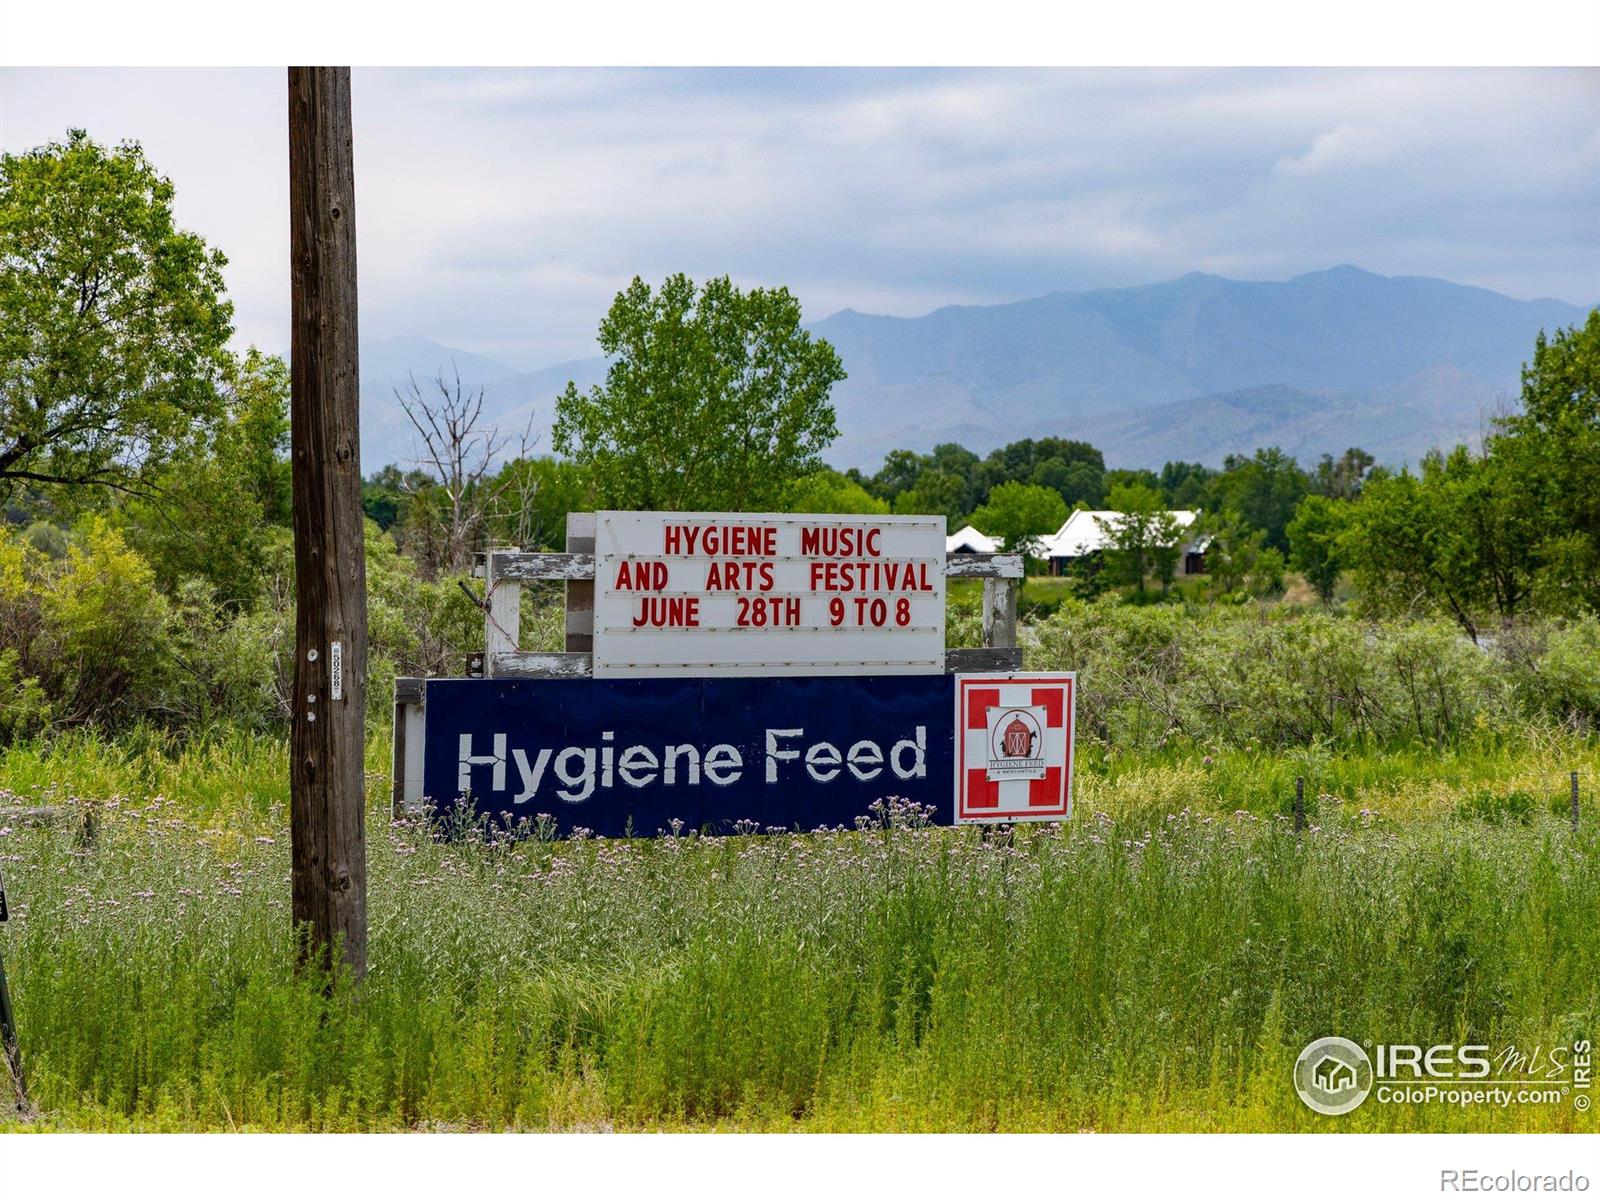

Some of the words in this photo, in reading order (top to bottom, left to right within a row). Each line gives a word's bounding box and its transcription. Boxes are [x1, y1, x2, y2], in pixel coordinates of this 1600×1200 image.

[664, 526, 777, 556] HYGIENE
[801, 528, 881, 557] MUSIC
[615, 561, 669, 591] AND
[705, 562, 774, 591] ARTS
[810, 563, 933, 591] FESTIVAL
[632, 598, 700, 627] JUNE
[736, 597, 801, 627] 28TH
[829, 597, 845, 627] 9
[854, 598, 887, 627] TO
[895, 597, 911, 627] 8
[458, 731, 743, 803] Hygiene
[765, 726, 926, 782] Feed
[990, 760, 1024, 768] HYGIENE
